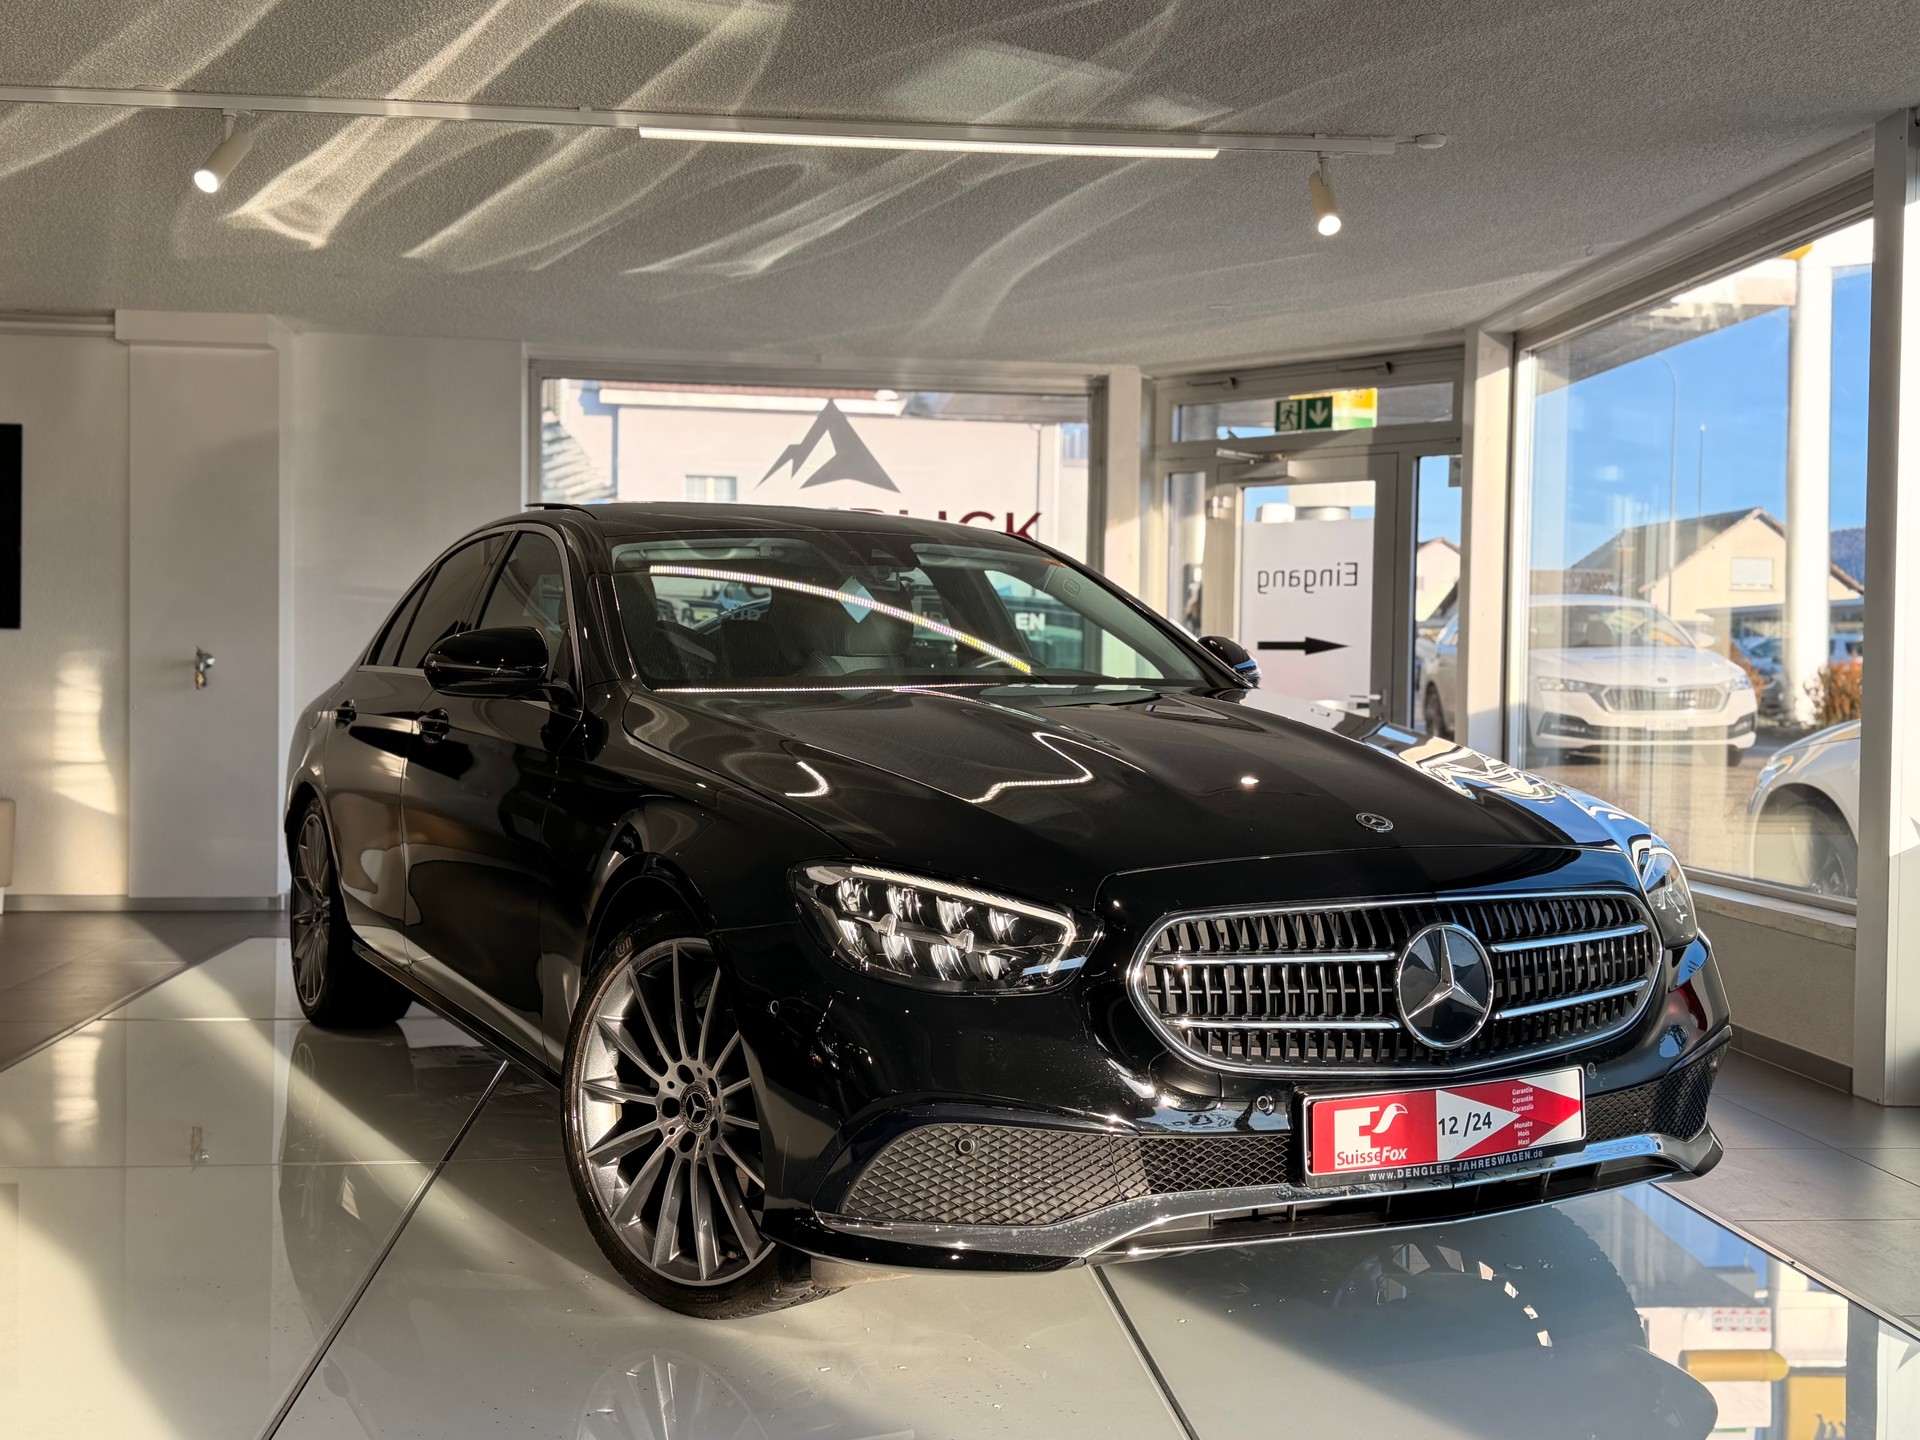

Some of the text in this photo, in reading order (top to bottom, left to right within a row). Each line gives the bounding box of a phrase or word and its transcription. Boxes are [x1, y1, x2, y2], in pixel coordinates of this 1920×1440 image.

[1512, 1086, 1534, 1096] Garantie
[1512, 1095, 1534, 1104] Garantie
[1512, 1104, 1534, 1113] Garanzia
[1514, 1121, 1533, 1130] Monate
[1517, 1129, 1530, 1138] Mois
[1517, 1138, 1530, 1147] Mesi
[1369, 1149, 1543, 1181] www.DENGLER-JAHRESWAGEN.de
